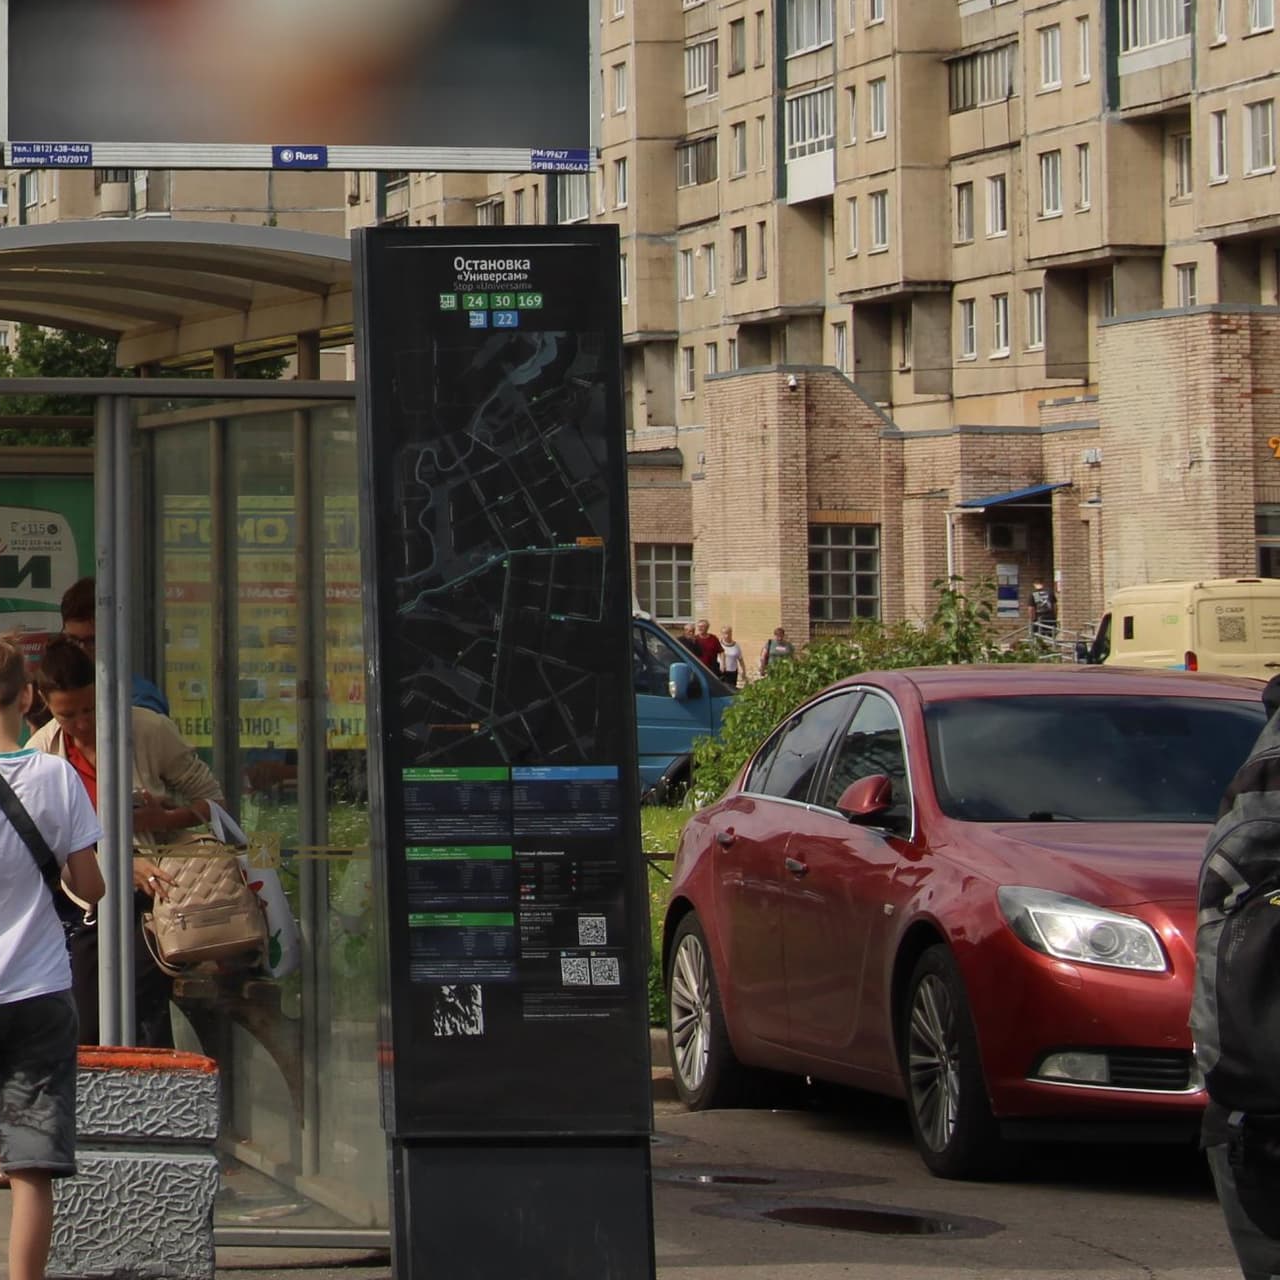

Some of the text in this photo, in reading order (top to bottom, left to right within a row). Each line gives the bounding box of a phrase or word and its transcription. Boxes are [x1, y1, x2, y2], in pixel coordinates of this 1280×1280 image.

[295, 151, 319, 160] Russ
[453, 256, 531, 271] Остановка
[456, 271, 529, 282] «Универсам»
[467, 295, 542, 307] 24 30 169
[498, 313, 513, 324] 22
